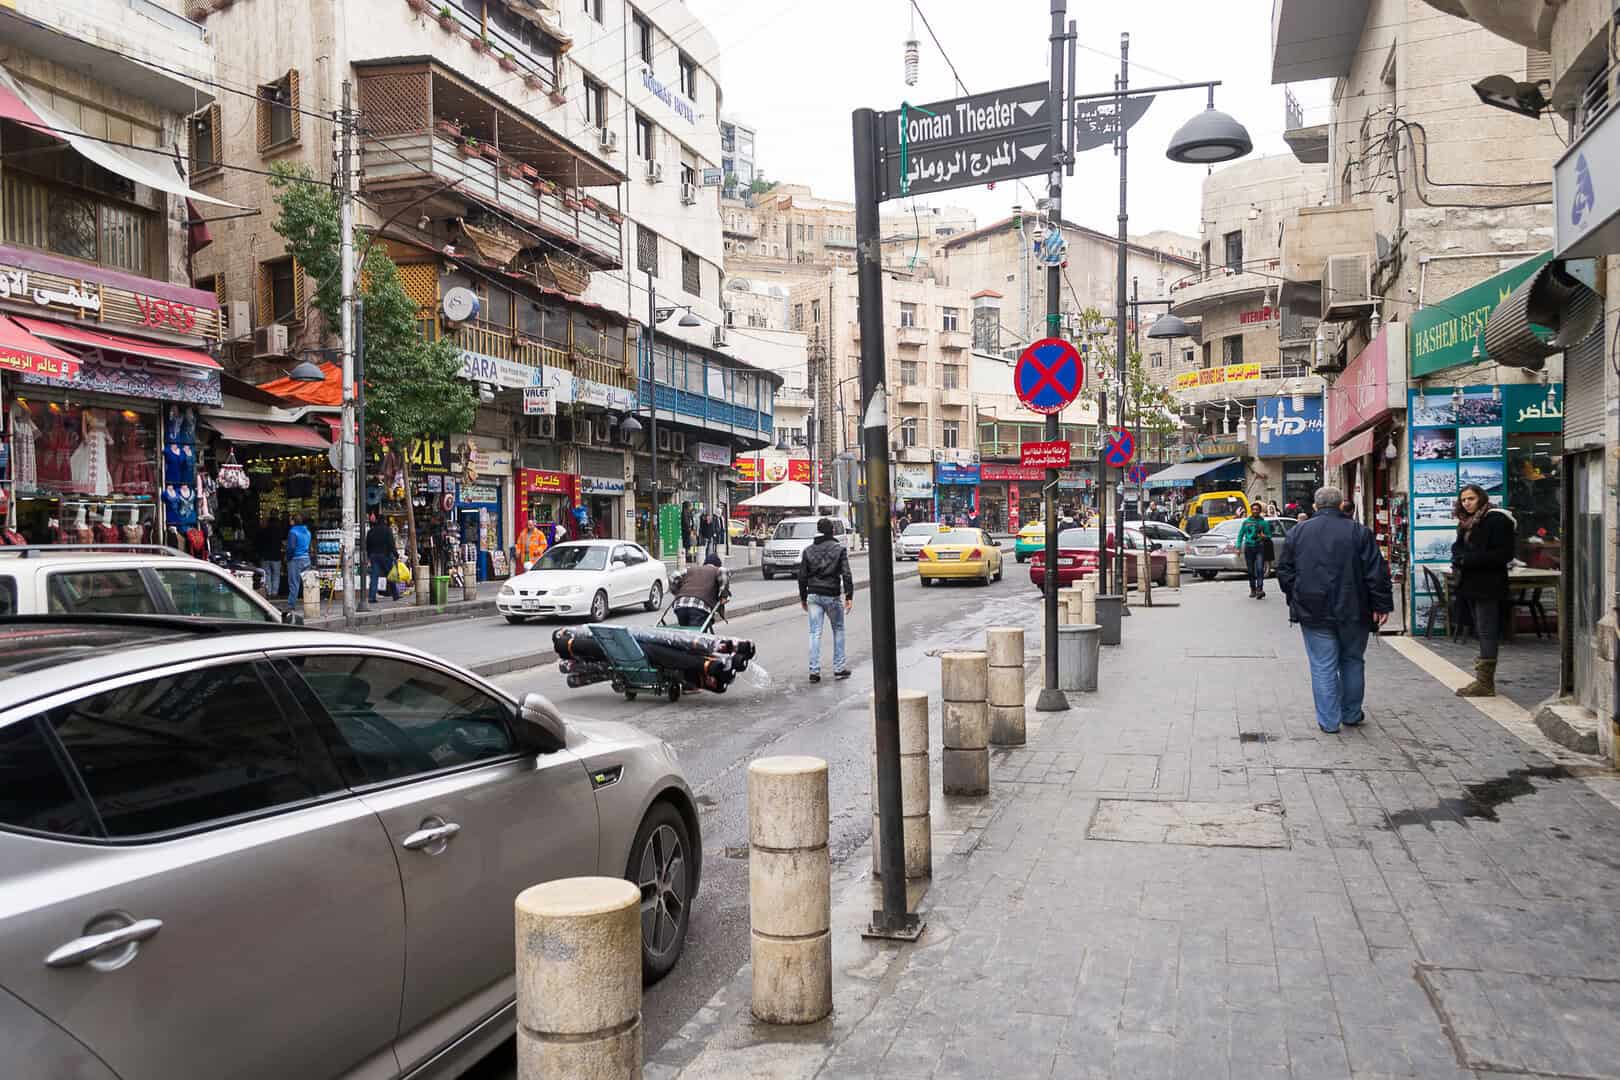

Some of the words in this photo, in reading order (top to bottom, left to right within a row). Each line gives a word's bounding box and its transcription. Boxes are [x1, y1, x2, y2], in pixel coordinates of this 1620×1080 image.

[955, 99, 1018, 133] Theater
[900, 149, 966, 193] الروماني
[970, 141, 1016, 177] المدرج
[1415, 318, 1458, 357] HASHEM
[464, 354, 498, 380] SARA
[525, 389, 549, 398] VALET
